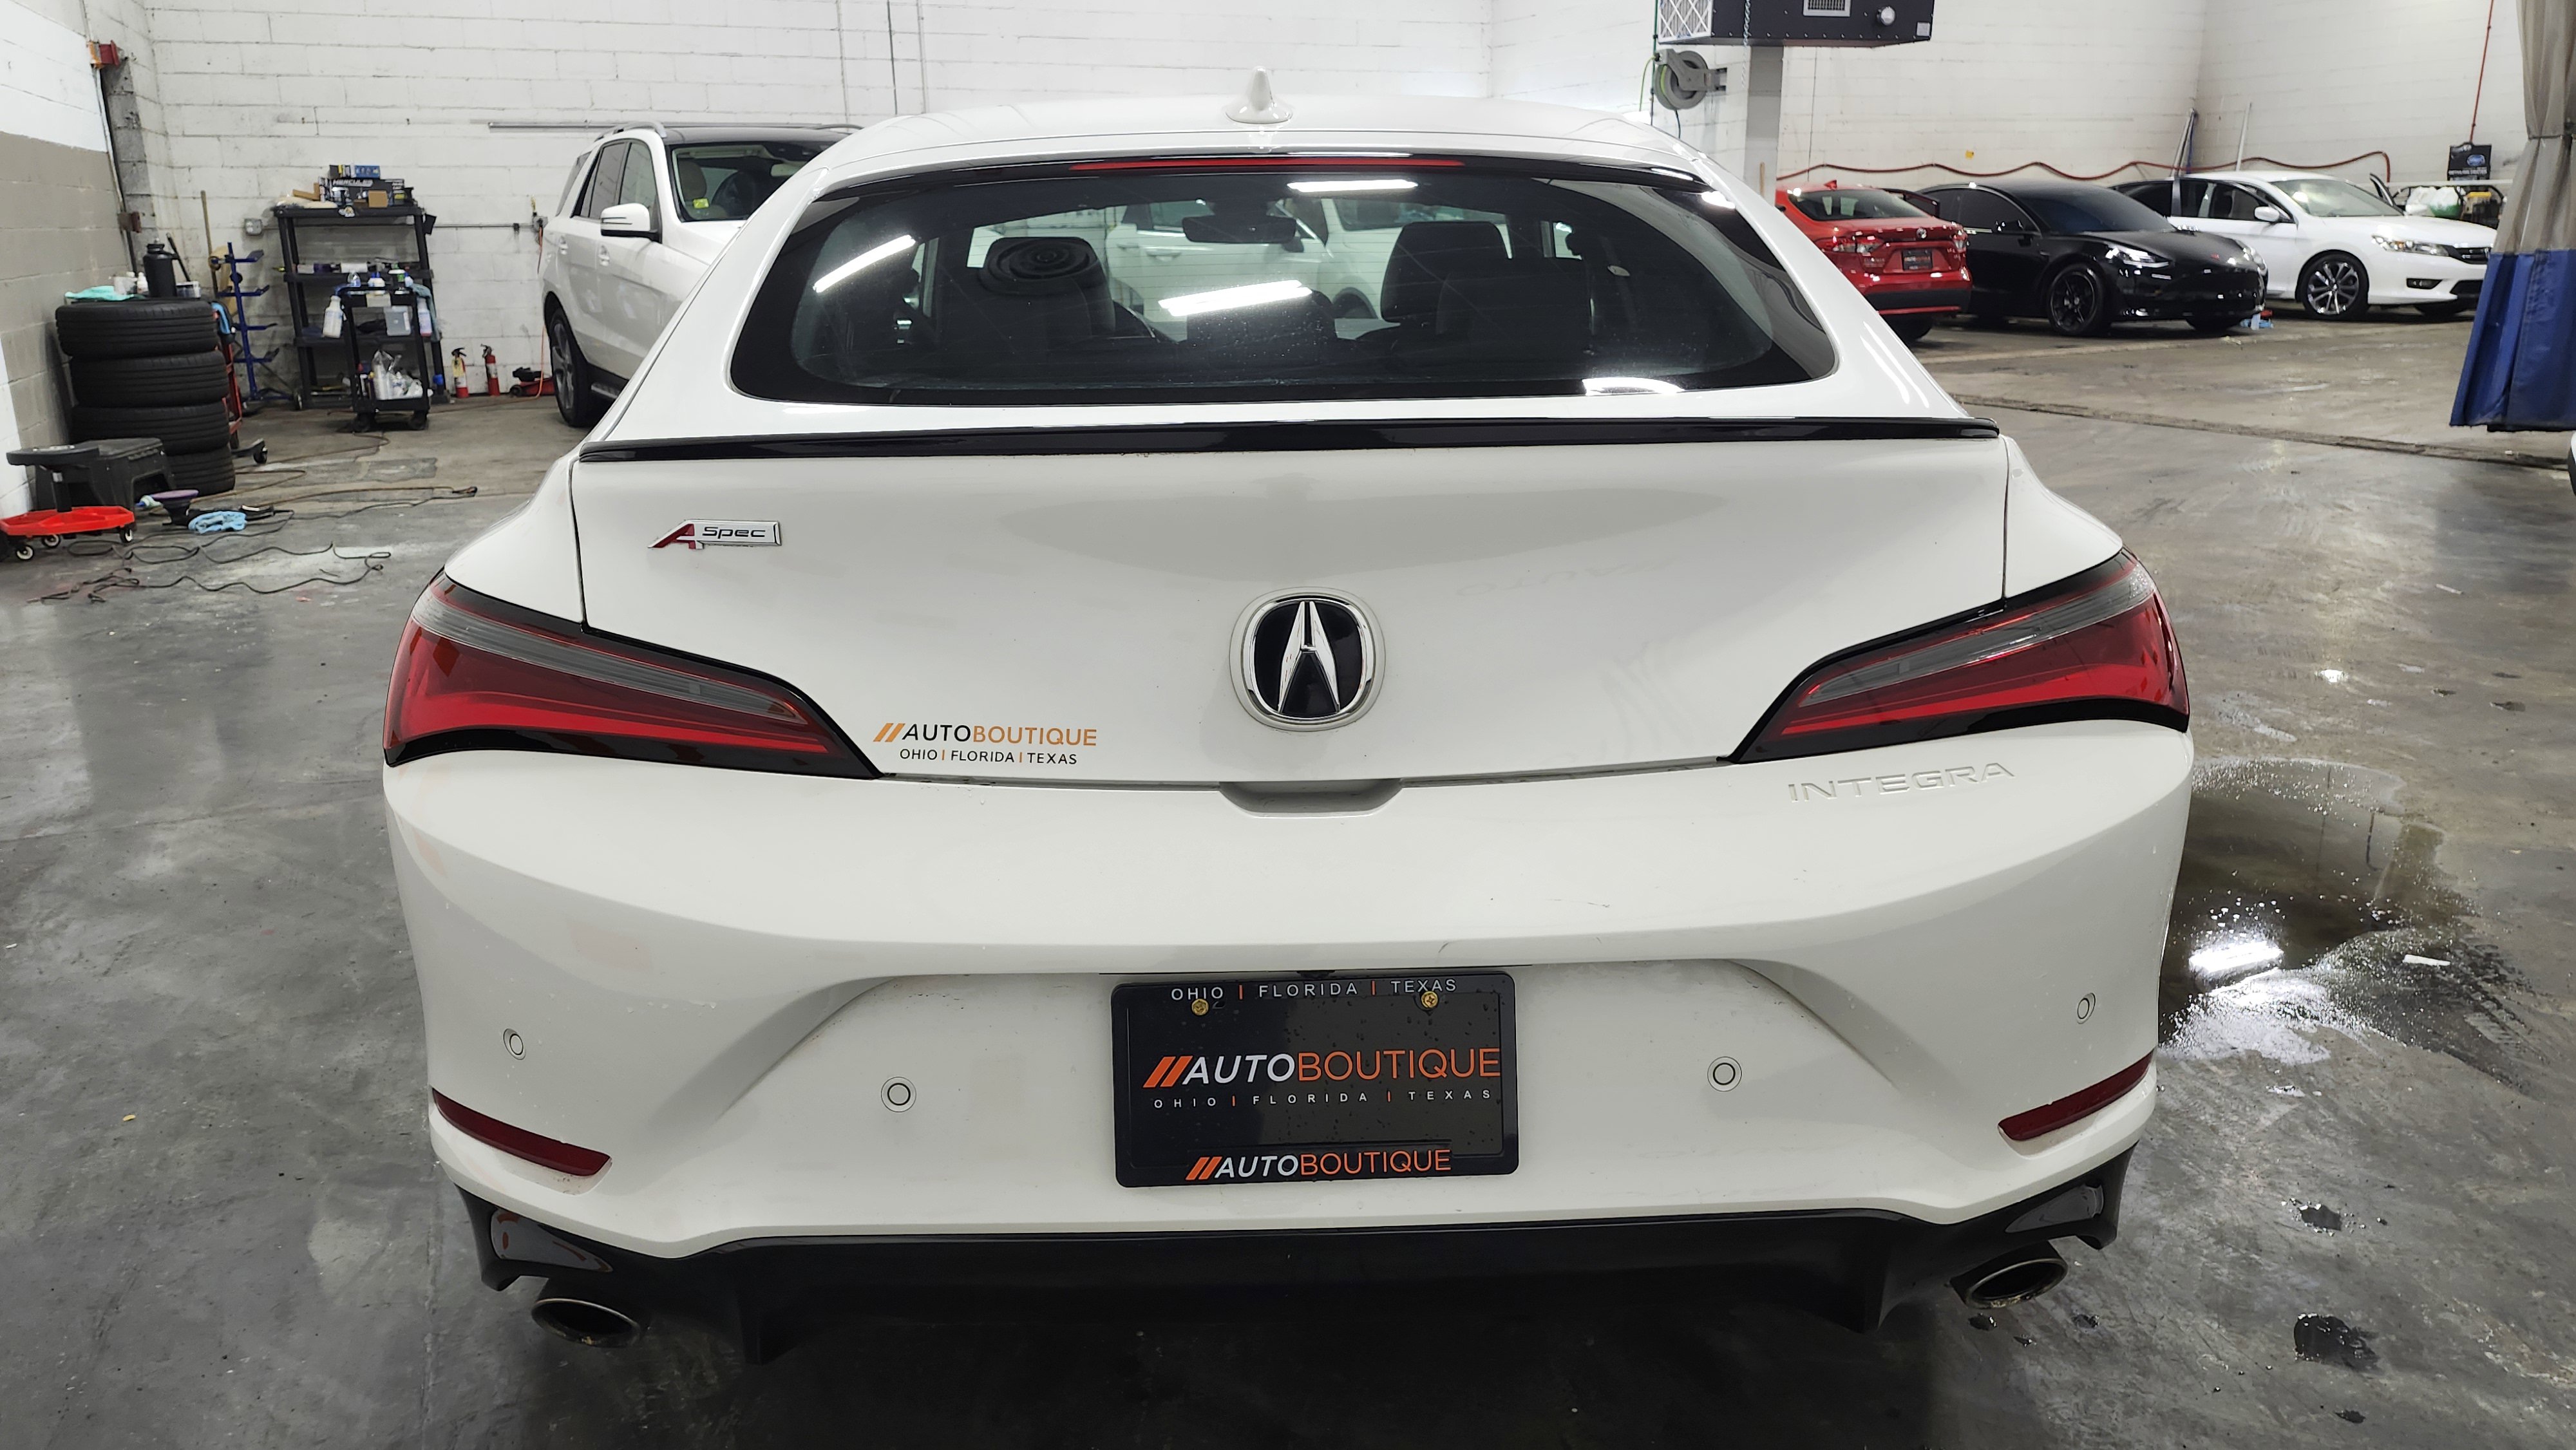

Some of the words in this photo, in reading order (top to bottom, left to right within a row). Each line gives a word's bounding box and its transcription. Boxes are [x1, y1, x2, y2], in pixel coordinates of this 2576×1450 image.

[703, 527, 766, 539] Spec
[902, 723, 1097, 746] AUTOBOUTIQUE
[900, 748, 938, 761] OHIO
[951, 750, 1015, 763] FLORIDA
[1027, 752, 1077, 765] TEXAS
[1788, 762, 2016, 803] INTEGRA
[1171, 986, 1224, 1000] OHIO
[1259, 982, 1358, 997] FLORIDA
[1390, 979, 1457, 993] TEXAS
[1182, 1048, 1501, 1085] AUTOBOUTIQUE
[1153, 1097, 1217, 1108] OHIO
[1253, 1093, 1367, 1105] FLORIDA
[1408, 1090, 1491, 1101] TEXAS
[1215, 1149, 1452, 1178] AUTOBOUTIQUE
